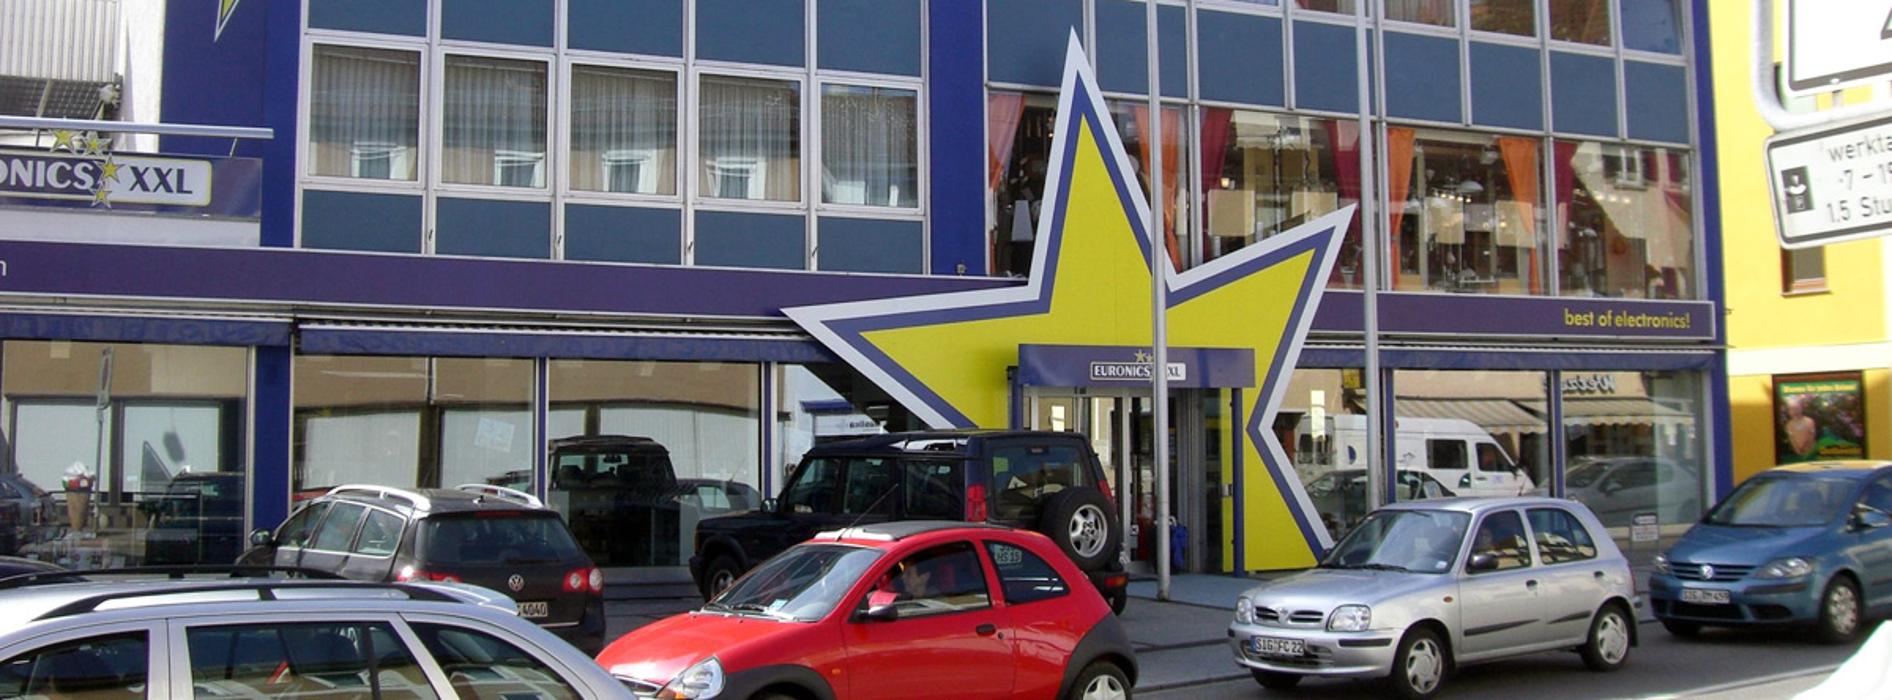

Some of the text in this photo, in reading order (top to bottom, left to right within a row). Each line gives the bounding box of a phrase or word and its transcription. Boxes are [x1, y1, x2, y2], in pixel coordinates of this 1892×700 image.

[129, 166, 193, 195] XXL
[1564, 308, 1691, 329] best of electronics!
[1093, 364, 1151, 377] EURONICS
